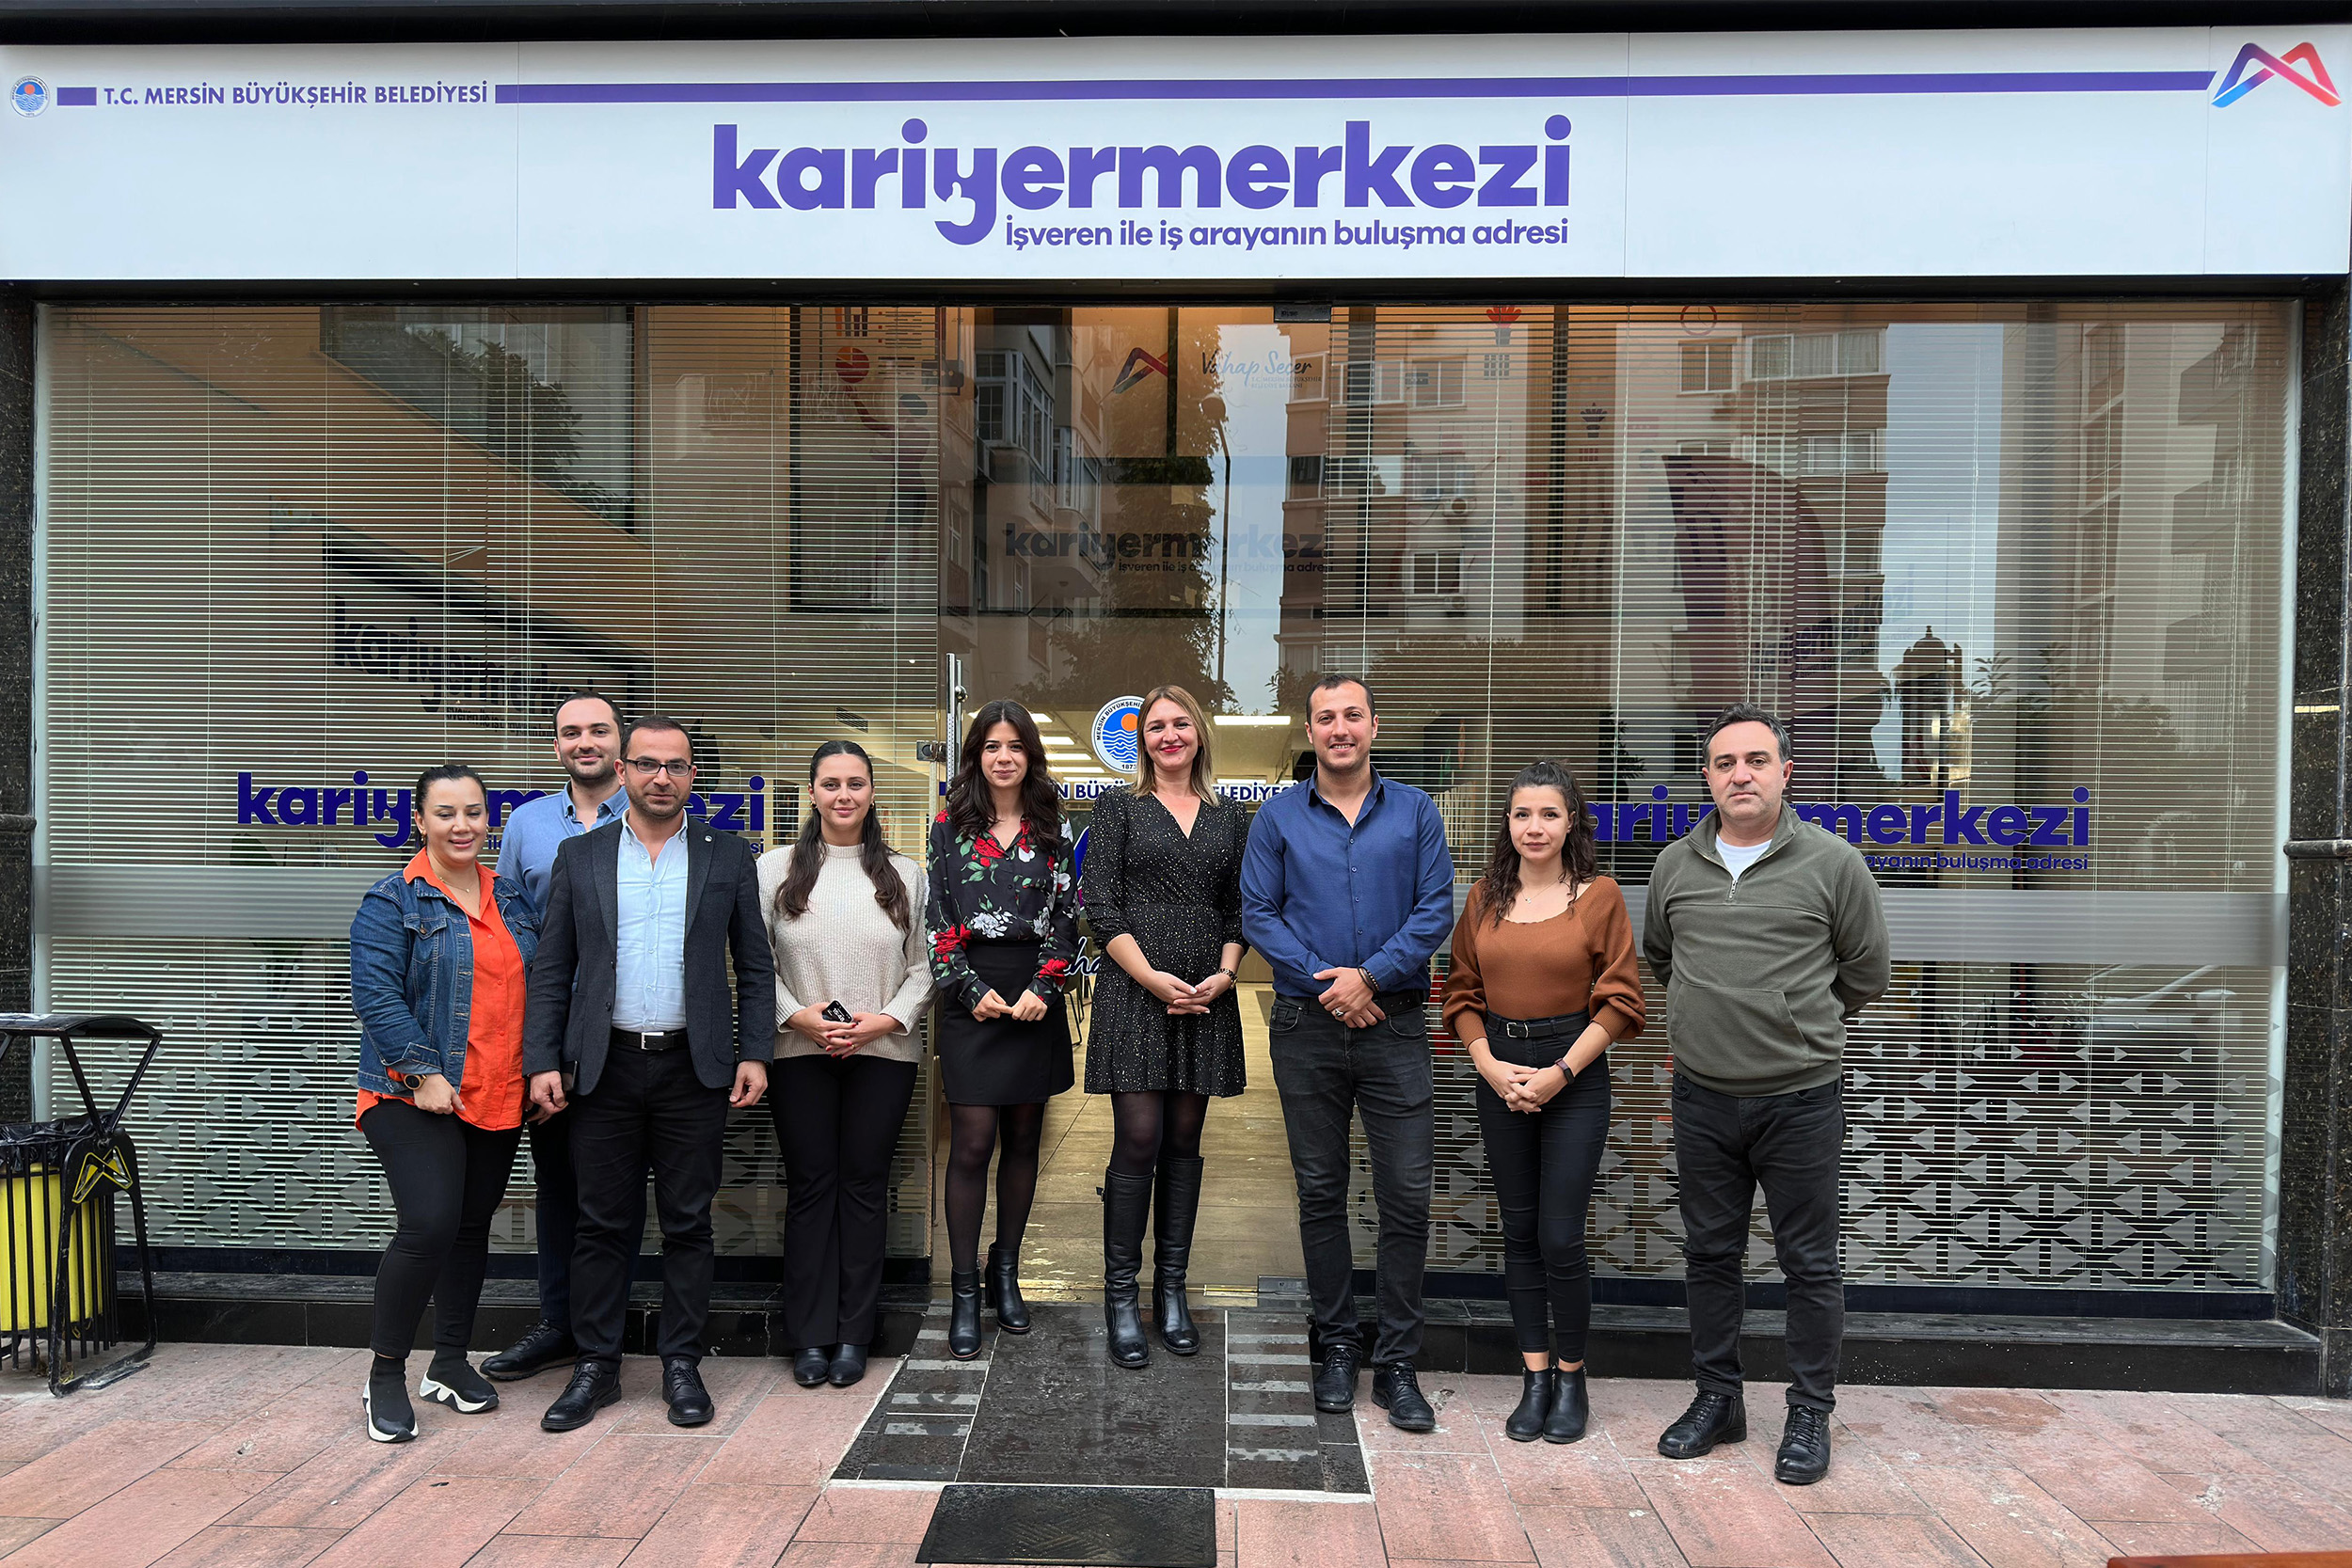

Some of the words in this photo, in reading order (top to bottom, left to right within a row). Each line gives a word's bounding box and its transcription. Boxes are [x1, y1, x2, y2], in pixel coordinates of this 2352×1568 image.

[103, 87, 138, 105] T.C.
[144, 82, 225, 105] MERSİN
[232, 81, 368, 109] BÜYÜKŞEHİR
[374, 80, 488, 103] BELEDİYESİ
[712, 114, 1572, 245] kariyermerkezi
[1006, 214, 1113, 251] İşveren
[1120, 219, 1153, 246] ile
[1159, 219, 1184, 251] iş
[1189, 226, 1327, 251] arayanın
[1334, 219, 1466, 250] buluşma
[1472, 217, 1569, 245] adresi
[1201, 348, 1261, 388] Vahap
[1864, 854, 1931, 871] ayanın
[1936, 852, 2022, 872] buluşma
[2026, 853, 2089, 870] adresi
